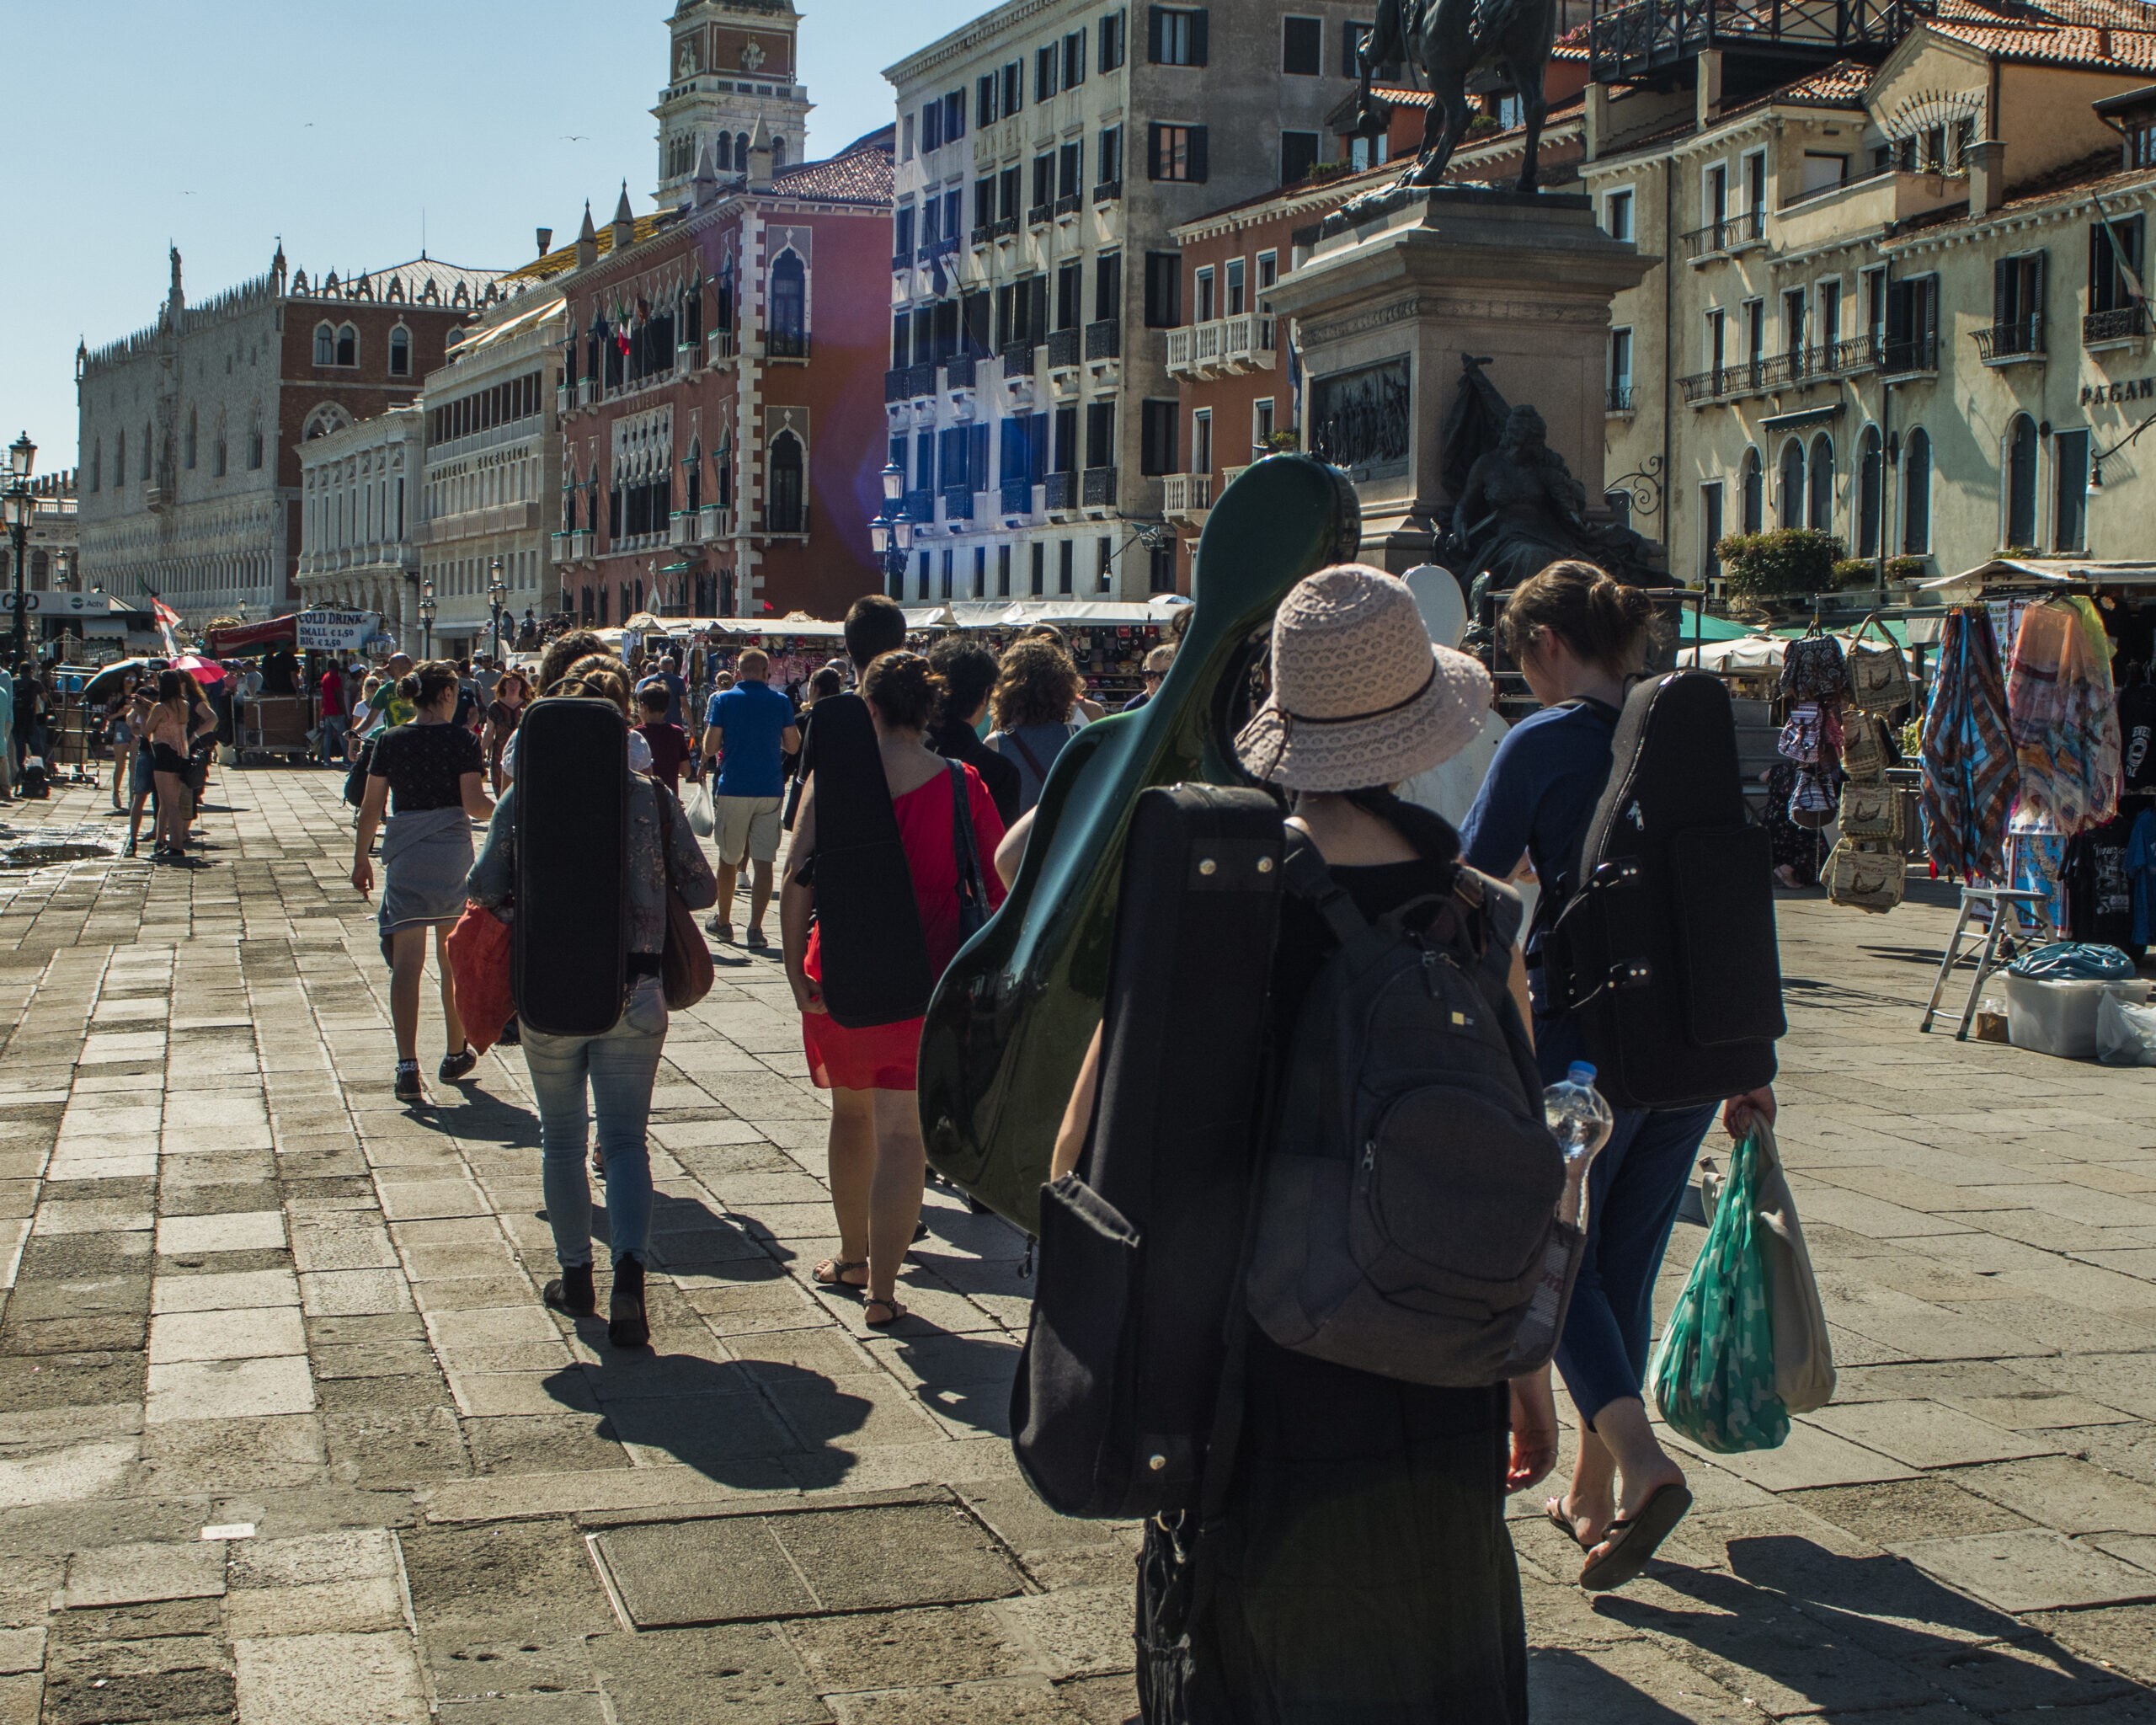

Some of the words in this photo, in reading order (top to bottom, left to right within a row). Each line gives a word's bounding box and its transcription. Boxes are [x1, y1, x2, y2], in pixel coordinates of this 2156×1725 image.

[432, 462, 467, 481] DANIELI
[478, 445, 528, 469] EXCELSIOR
[298, 612, 326, 624] COLD
[300, 627, 328, 637] SMALL
[300, 637, 314, 646] BIG
